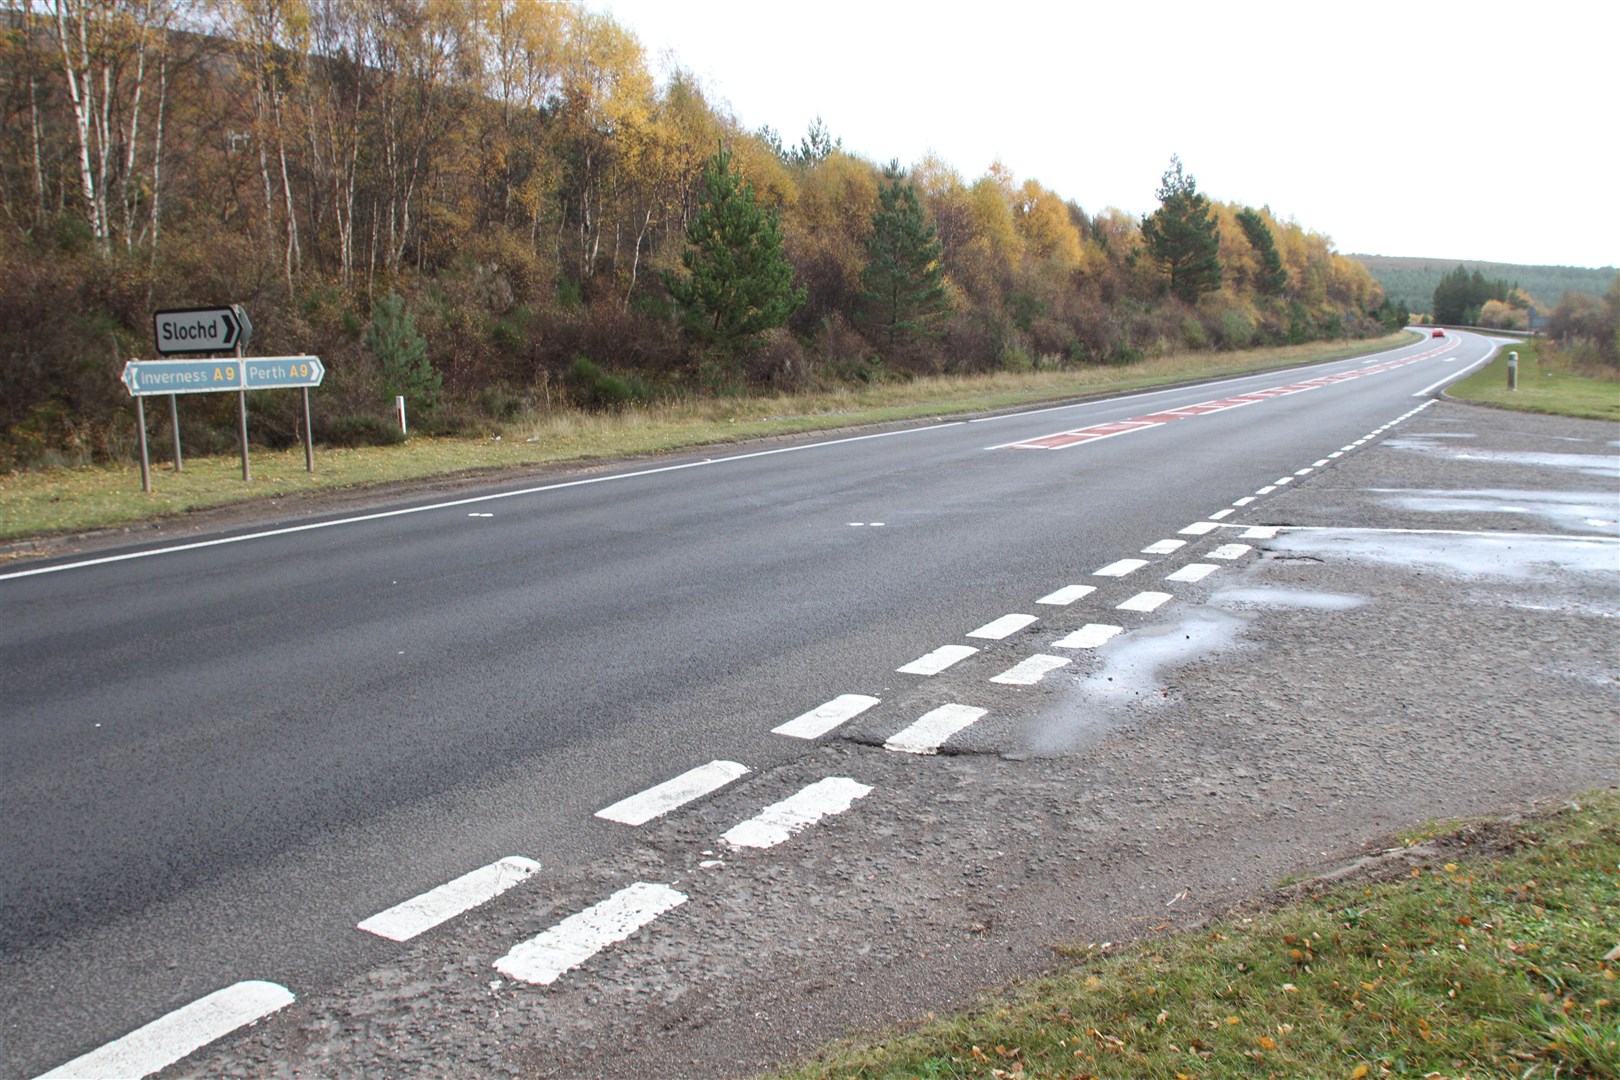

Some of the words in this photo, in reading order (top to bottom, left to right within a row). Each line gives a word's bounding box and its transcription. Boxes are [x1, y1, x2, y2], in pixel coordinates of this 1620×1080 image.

[162, 320, 217, 340] Slochd
[141, 369, 208, 385] Inverness
[213, 367, 235, 381] A9
[249, 366, 286, 380] Perth
[289, 364, 309, 378] A9
